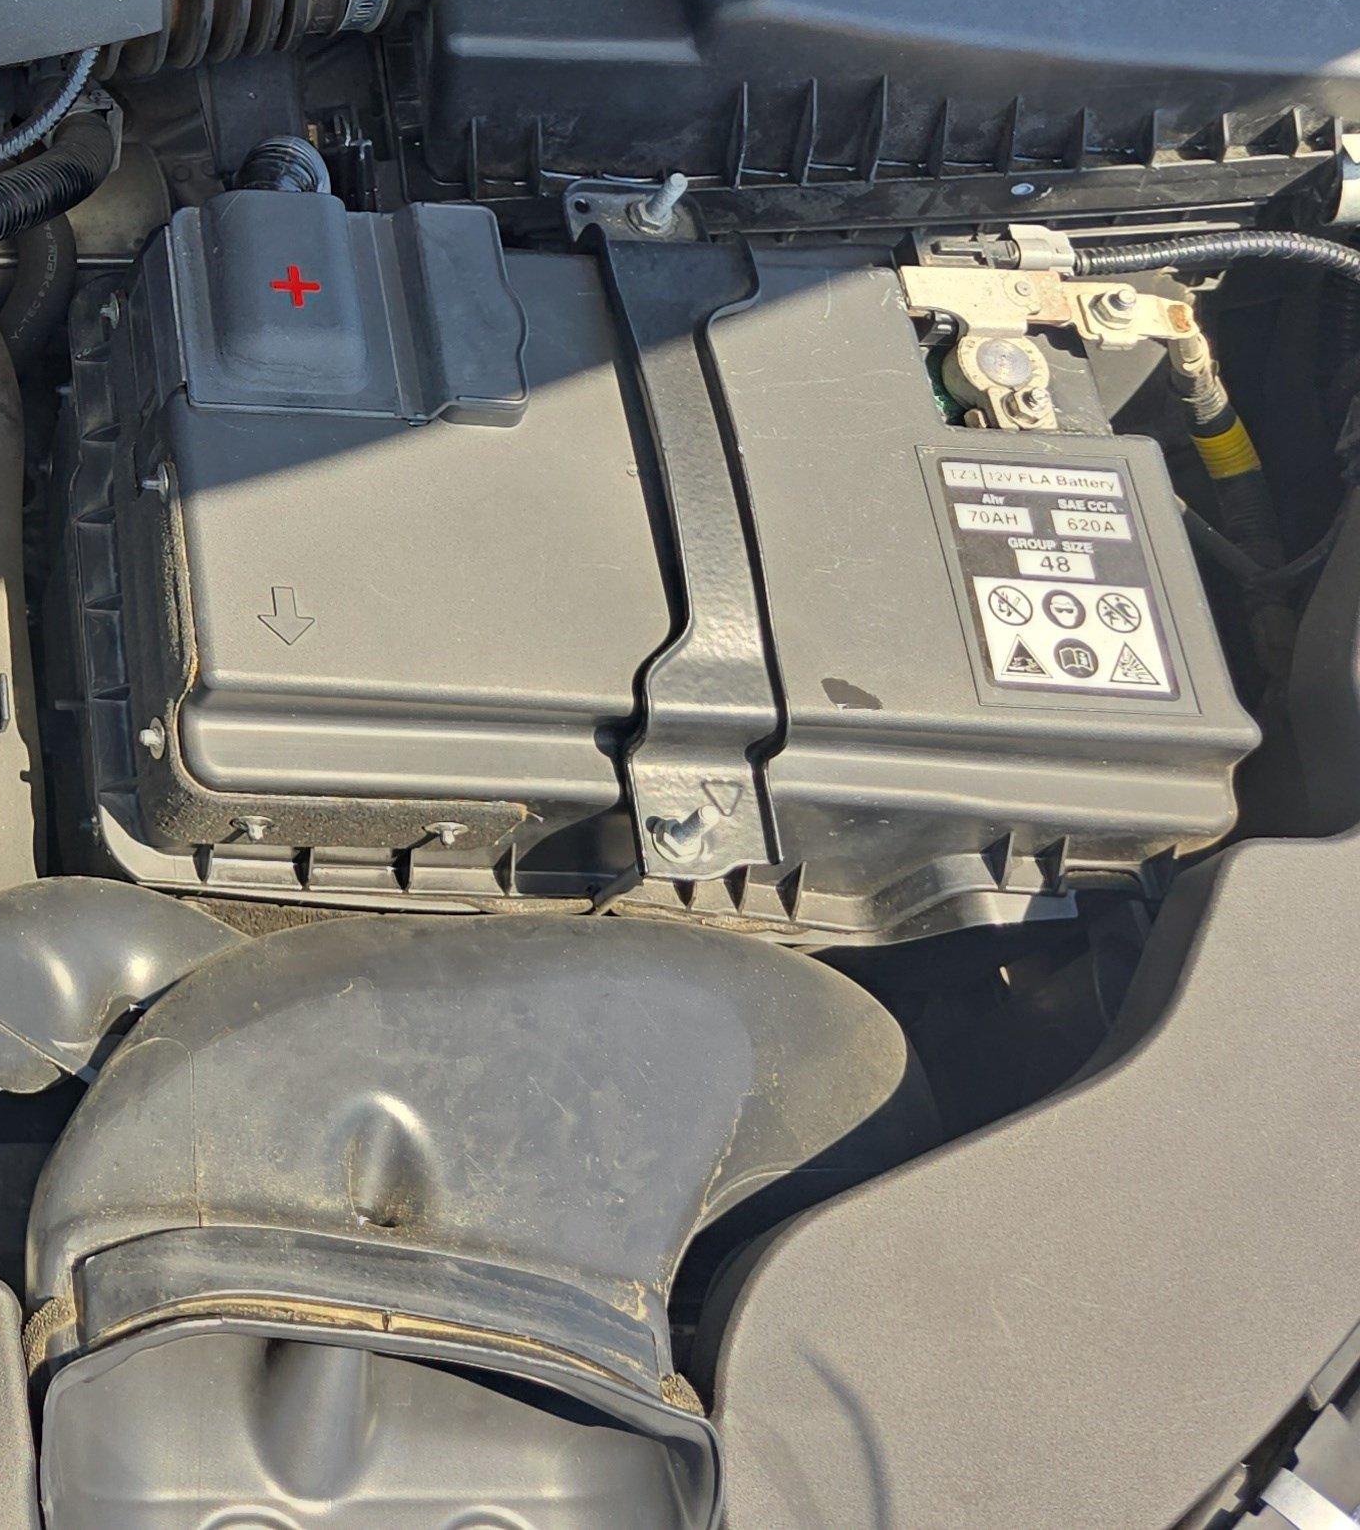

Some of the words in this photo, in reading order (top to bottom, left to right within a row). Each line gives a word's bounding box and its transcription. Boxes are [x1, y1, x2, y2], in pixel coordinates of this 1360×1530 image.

[987, 470, 1013, 483] 12V
[1018, 473, 1052, 486] FLA
[1056, 475, 1115, 493] Battery
[982, 493, 1005, 506] Ahr
[1058, 498, 1085, 512] SAE
[1087, 500, 1117, 513] CCA
[967, 510, 1018, 526] 70AH
[1067, 517, 1116, 533] 620A
[1007, 537, 1056, 552] GROUP
[1061, 540, 1095, 554] SIZE
[1040, 556, 1071, 574] 48
